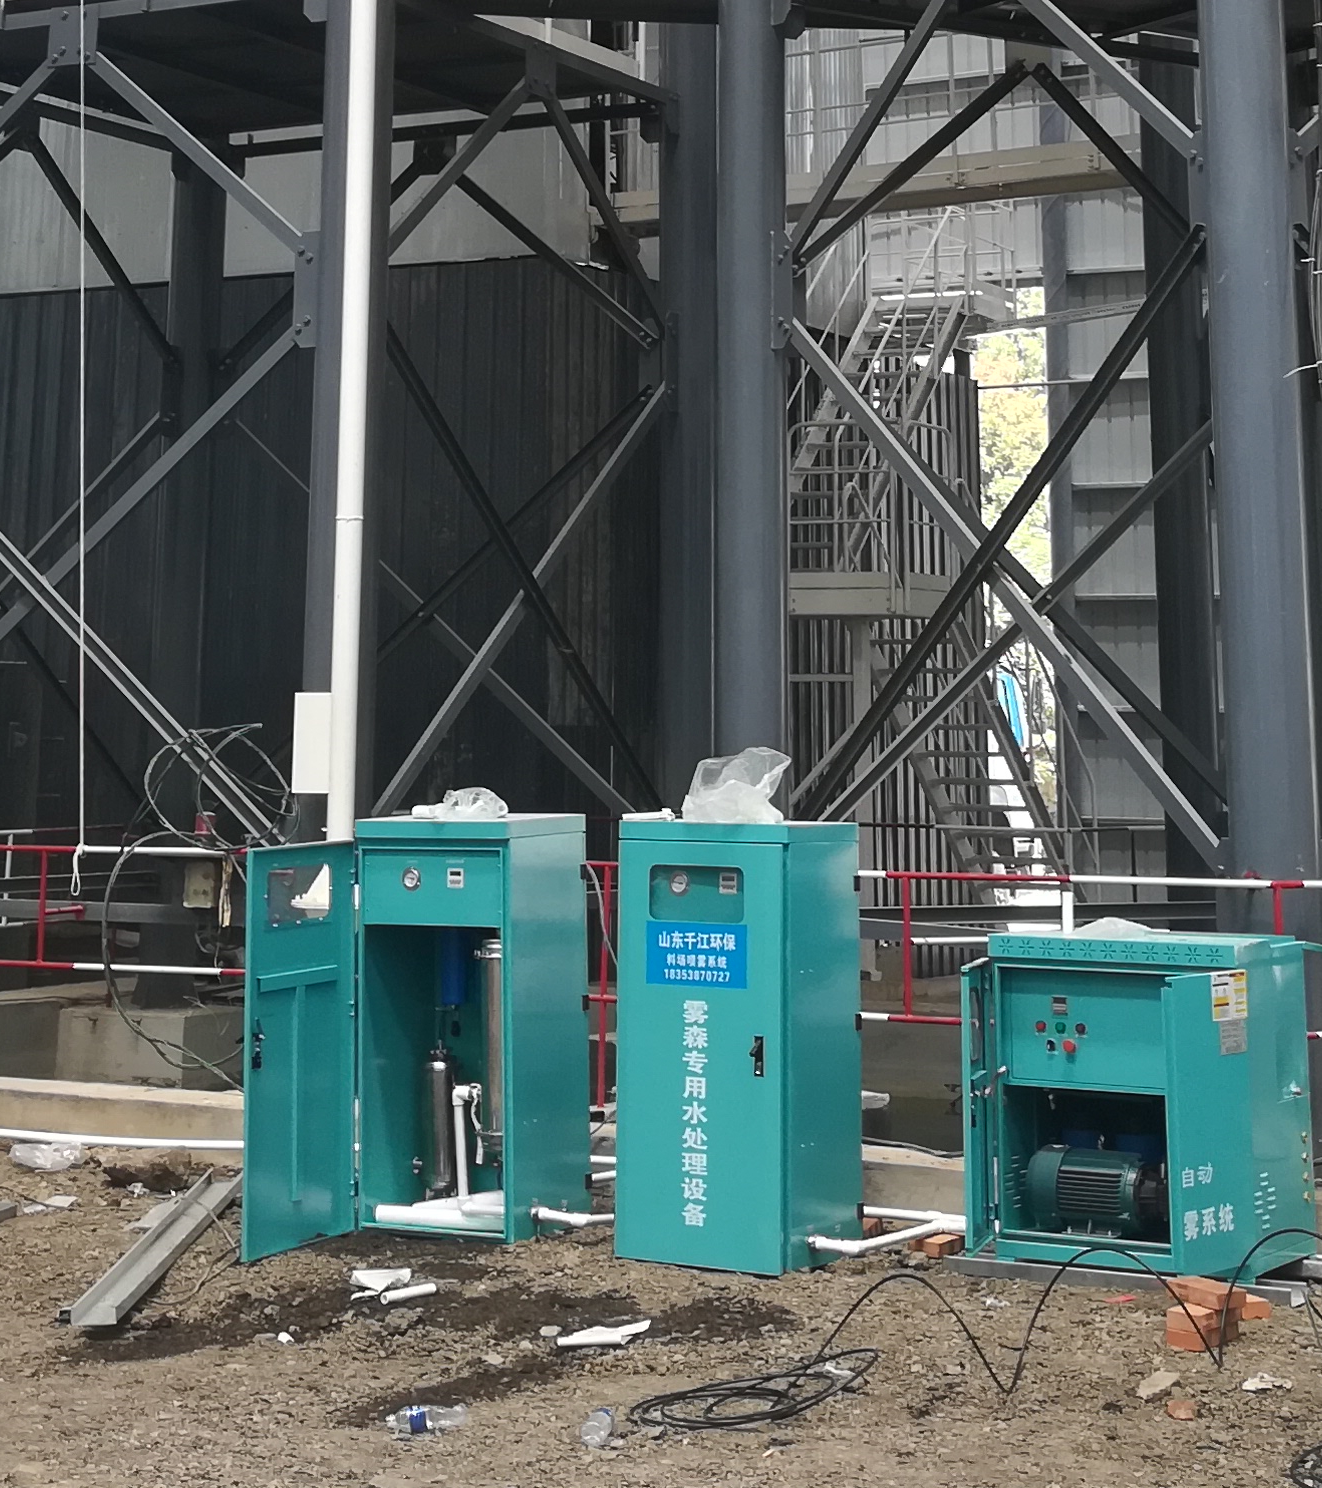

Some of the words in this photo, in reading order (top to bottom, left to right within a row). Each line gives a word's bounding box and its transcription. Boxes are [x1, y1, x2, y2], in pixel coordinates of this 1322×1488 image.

[658, 931, 736, 951] 山东千江环保
[666, 953, 727, 969] 料场喷雾系统
[664, 969, 730, 982] 18353870727
[681, 1000, 708, 1227] 雾森专用水处理设备
[1182, 1162, 1213, 1188] 自动
[1184, 1203, 1234, 1242] 雾系统
